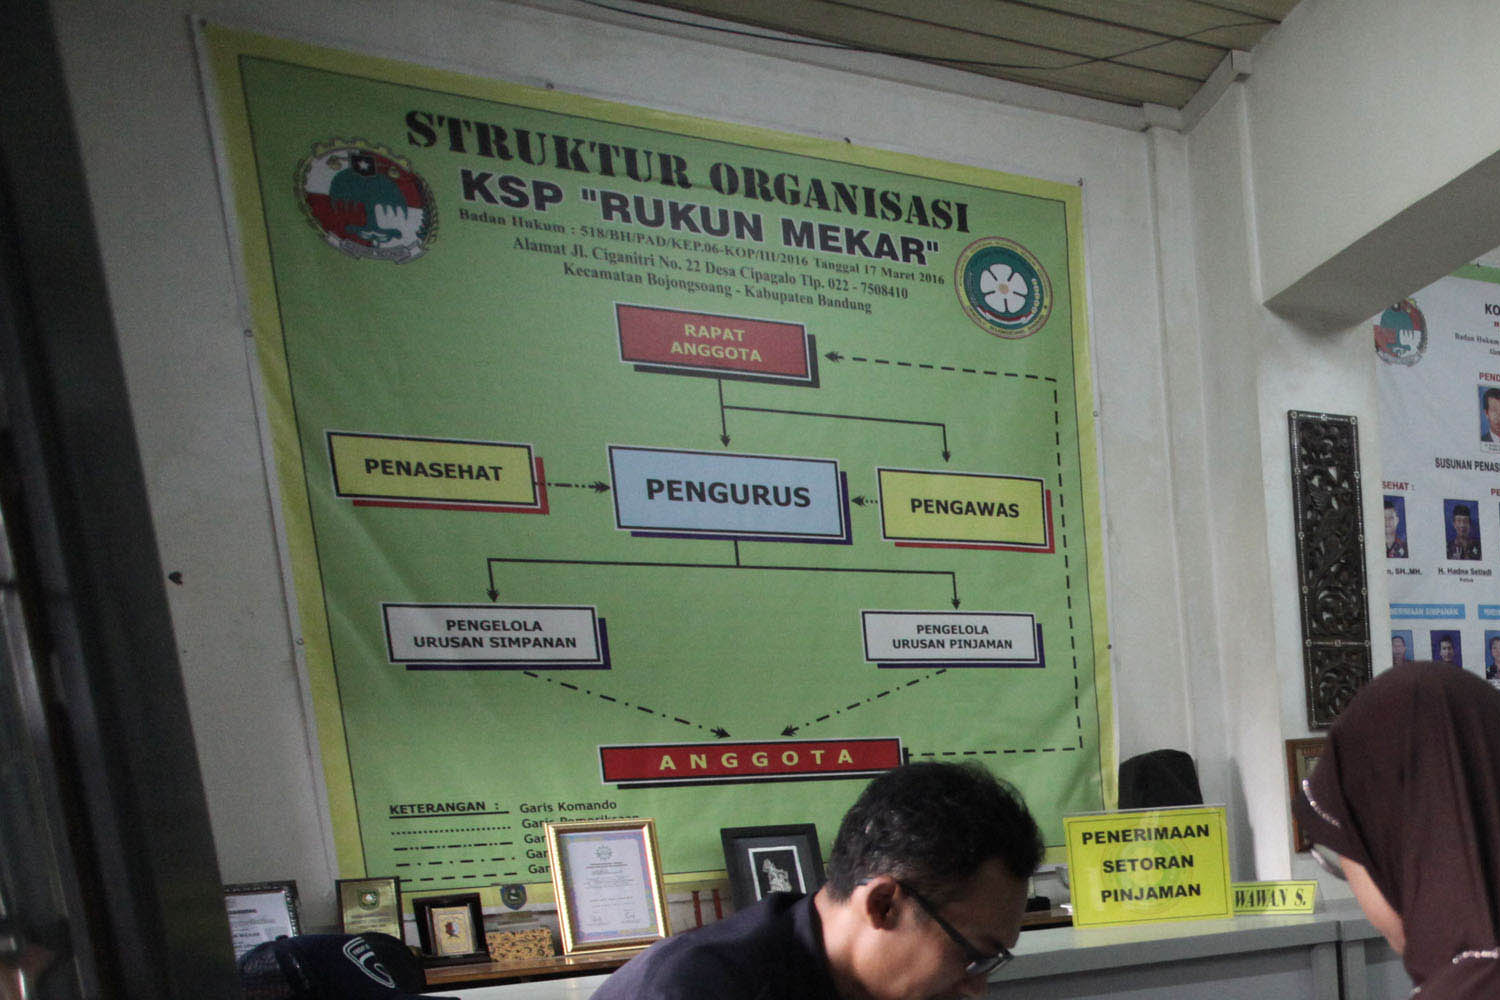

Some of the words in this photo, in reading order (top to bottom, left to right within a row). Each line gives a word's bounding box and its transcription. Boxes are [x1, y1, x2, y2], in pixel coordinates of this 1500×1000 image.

[405, 110, 692, 189] STRUKTUR
[709, 162, 970, 233] ORGANISASI
[460, 168, 563, 212] KSP
[581, 187, 764, 242] "RUKUN
[781, 217, 939, 266] MEKAR"
[459, 209, 506, 226] Badan
[512, 215, 565, 233] Hukum
[815, 257, 860, 274] Tanggal
[864, 265, 877, 276] 17
[881, 267, 915, 281] Maret
[919, 273, 945, 286] 2016
[513, 237, 567, 256] Alamat
[571, 243, 588, 259] Jl.
[592, 247, 655, 266] Ciganitri
[659, 256, 682, 271] No.
[686, 259, 700, 273] 22
[705, 261, 736, 277] Desa
[740, 266, 796, 286] Cipagalo
[800, 274, 824, 290] Tlp.
[828, 278, 849, 292] 022
[860, 282, 908, 299] 7508410
[563, 262, 643, 284] Kecamatan
[648, 272, 733, 298] Bojongsoang
[745, 285, 814, 305] Kabupaten
[818, 294, 873, 315] Bandung
[684, 323, 746, 342] RAPAT
[671, 341, 762, 362] ANGGOTA
[364, 458, 503, 481] PENASEHAT
[1435, 457, 1472, 470] SUSUNAN
[646, 477, 812, 508] PENGURUS
[1382, 481, 1410, 492] SEHAT
[911, 498, 1020, 518] PENGAWAS
[446, 619, 543, 632] PENGELOLA
[916, 624, 989, 635] PENGELOLA
[413, 636, 484, 648] URUSAN
[490, 636, 576, 648] SIMPANAN
[892, 639, 946, 649] URUSAN
[950, 639, 1013, 649] PINJAMAN
[389, 801, 486, 815] KETERANGAN
[519, 802, 553, 813] Garis
[558, 799, 617, 812] Komando
[524, 833, 546, 845] Gar
[1081, 823, 1209, 845] PENERIMAAN
[526, 848, 548, 860] Gar
[528, 863, 551, 875] Gar
[1103, 854, 1194, 874] SETORAN
[1100, 883, 1201, 903] PINJAMAN
[1235, 889, 1288, 908] WAWAN
